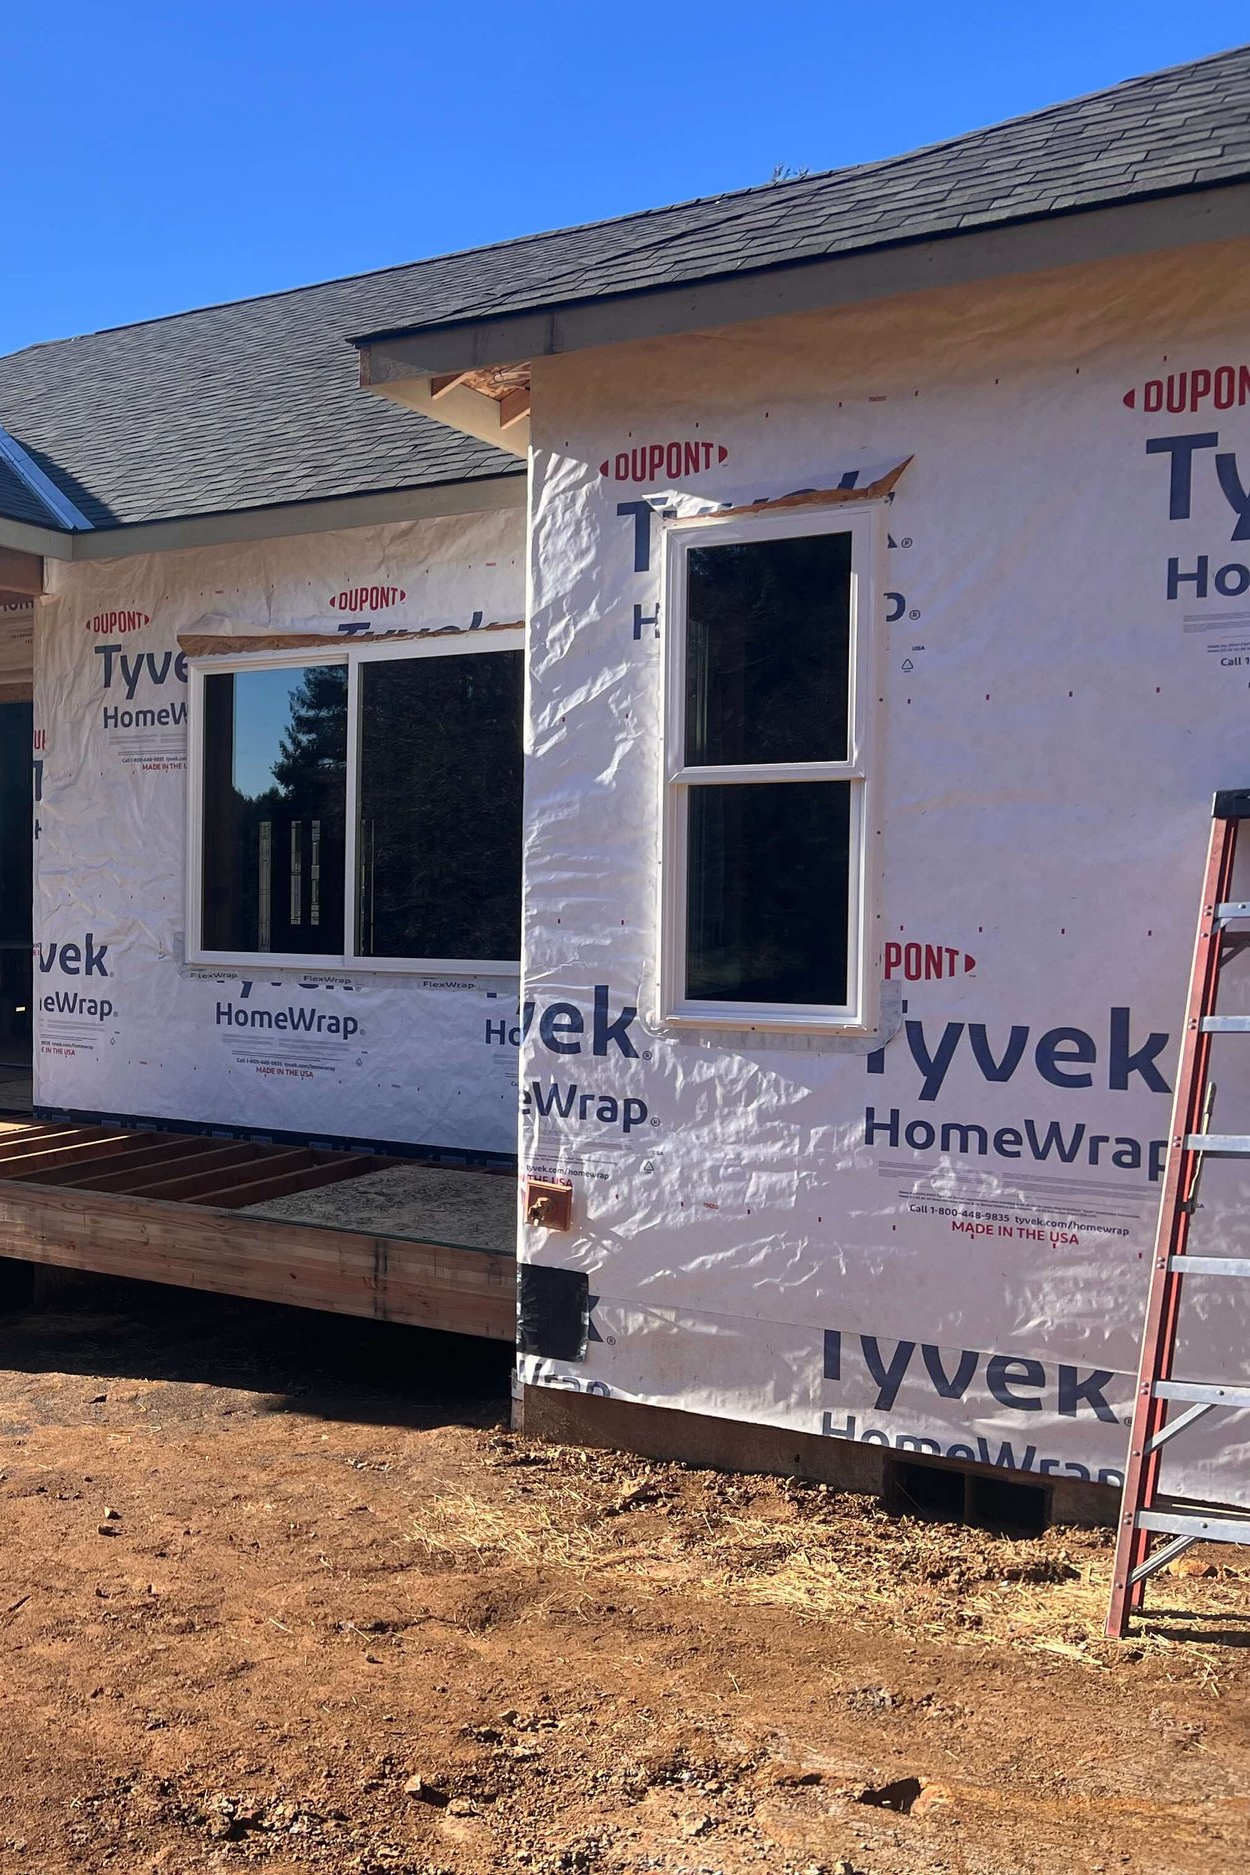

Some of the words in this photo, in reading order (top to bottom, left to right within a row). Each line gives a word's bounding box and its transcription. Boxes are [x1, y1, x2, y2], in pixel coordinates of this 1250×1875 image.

[615, 442, 713, 482] DUPONT
[338, 586, 399, 612] DUPONT
[93, 610, 143, 634] DUPONT
[884, 941, 959, 981] PONT
[303, 975, 352, 985] FlexWrap
[423, 981, 475, 990] FlexWrap
[39, 991, 113, 1021] eWrap
[216, 1002, 359, 1040] HomeWrap
[256, 1066, 275, 1075] MADE
[276, 1067, 284, 1076] IN
[285, 1069, 299, 1077] THE
[300, 1070, 314, 1078] USA
[526, 1164, 610, 1181] tyvek.com/homewrap
[909, 1204, 928, 1214] Call
[930, 1207, 1010, 1222] 1-800-448-9835
[1014, 1215, 1130, 1237] tyvek.com/homewrap
[951, 1220, 993, 1235] MADE
[998, 1223, 1013, 1237] IN
[1016, 1227, 1045, 1241] THE
[1050, 1230, 1079, 1245] USA
